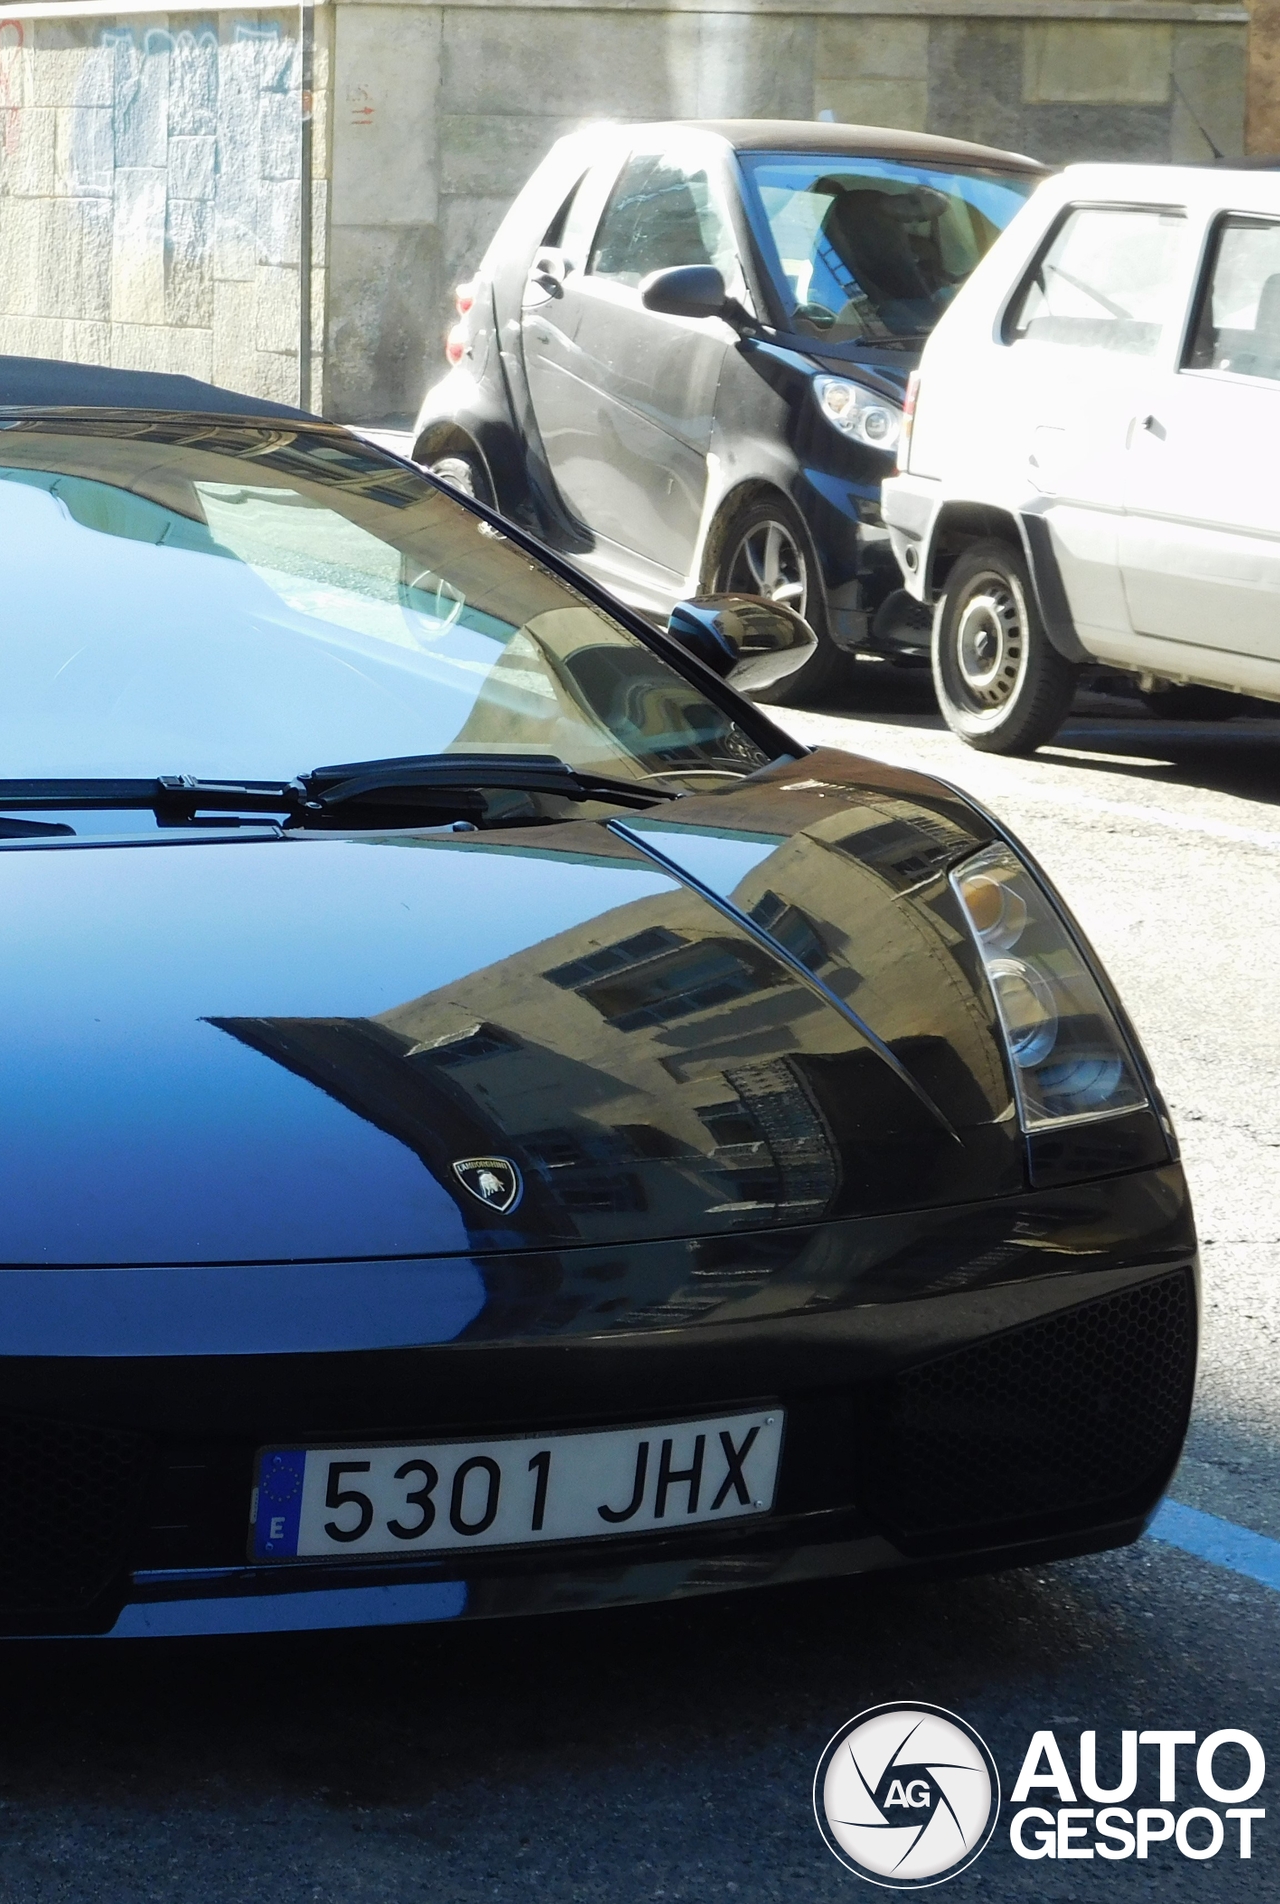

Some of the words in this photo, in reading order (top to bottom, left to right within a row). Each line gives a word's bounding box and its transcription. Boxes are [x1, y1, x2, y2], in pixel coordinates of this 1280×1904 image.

[323, 1450, 552, 1542] 5301
[597, 1426, 761, 1523] JHX
[269, 1516, 286, 1539] E
